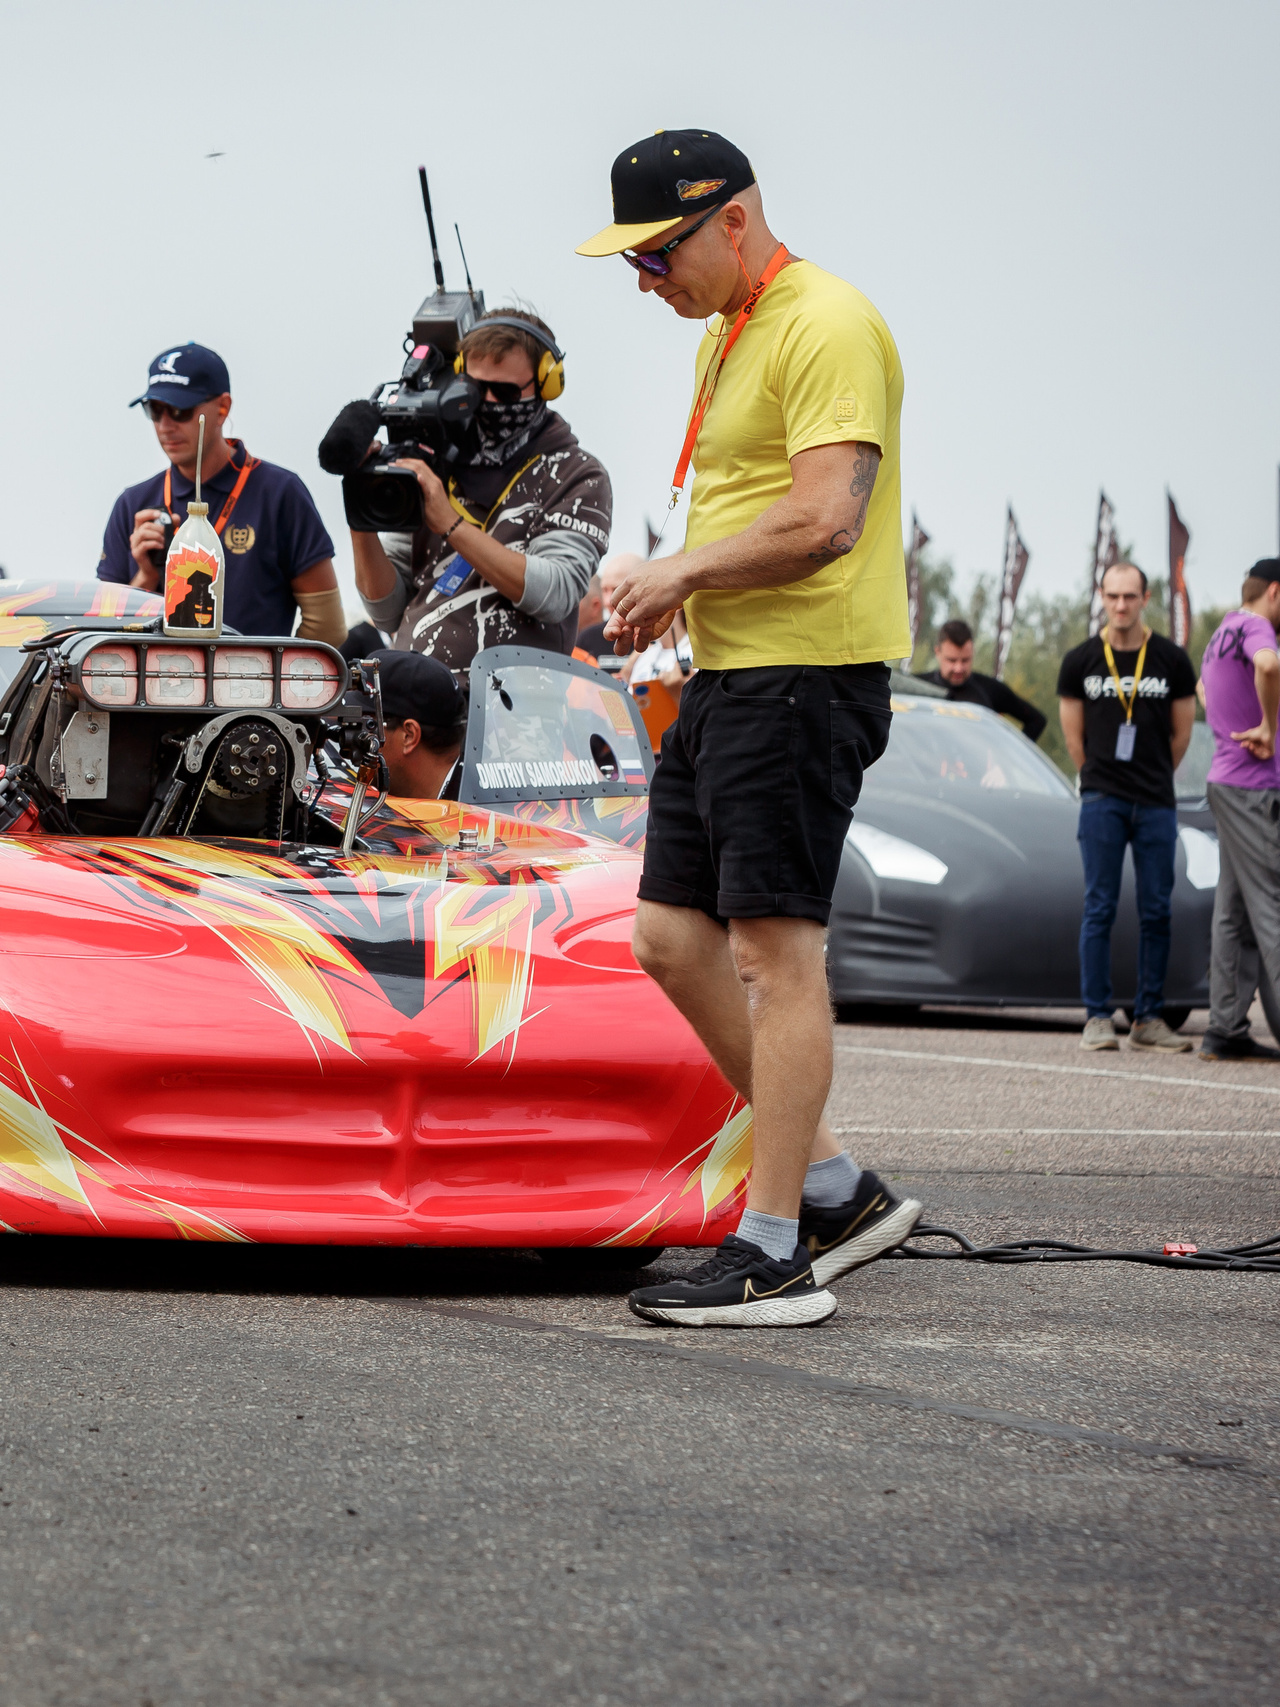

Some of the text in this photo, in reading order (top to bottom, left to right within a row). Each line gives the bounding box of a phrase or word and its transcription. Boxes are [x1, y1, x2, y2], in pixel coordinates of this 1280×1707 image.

[88, 652, 324, 699] RDRC
[476, 759, 599, 789] DMITRIY SAMORUKOV
